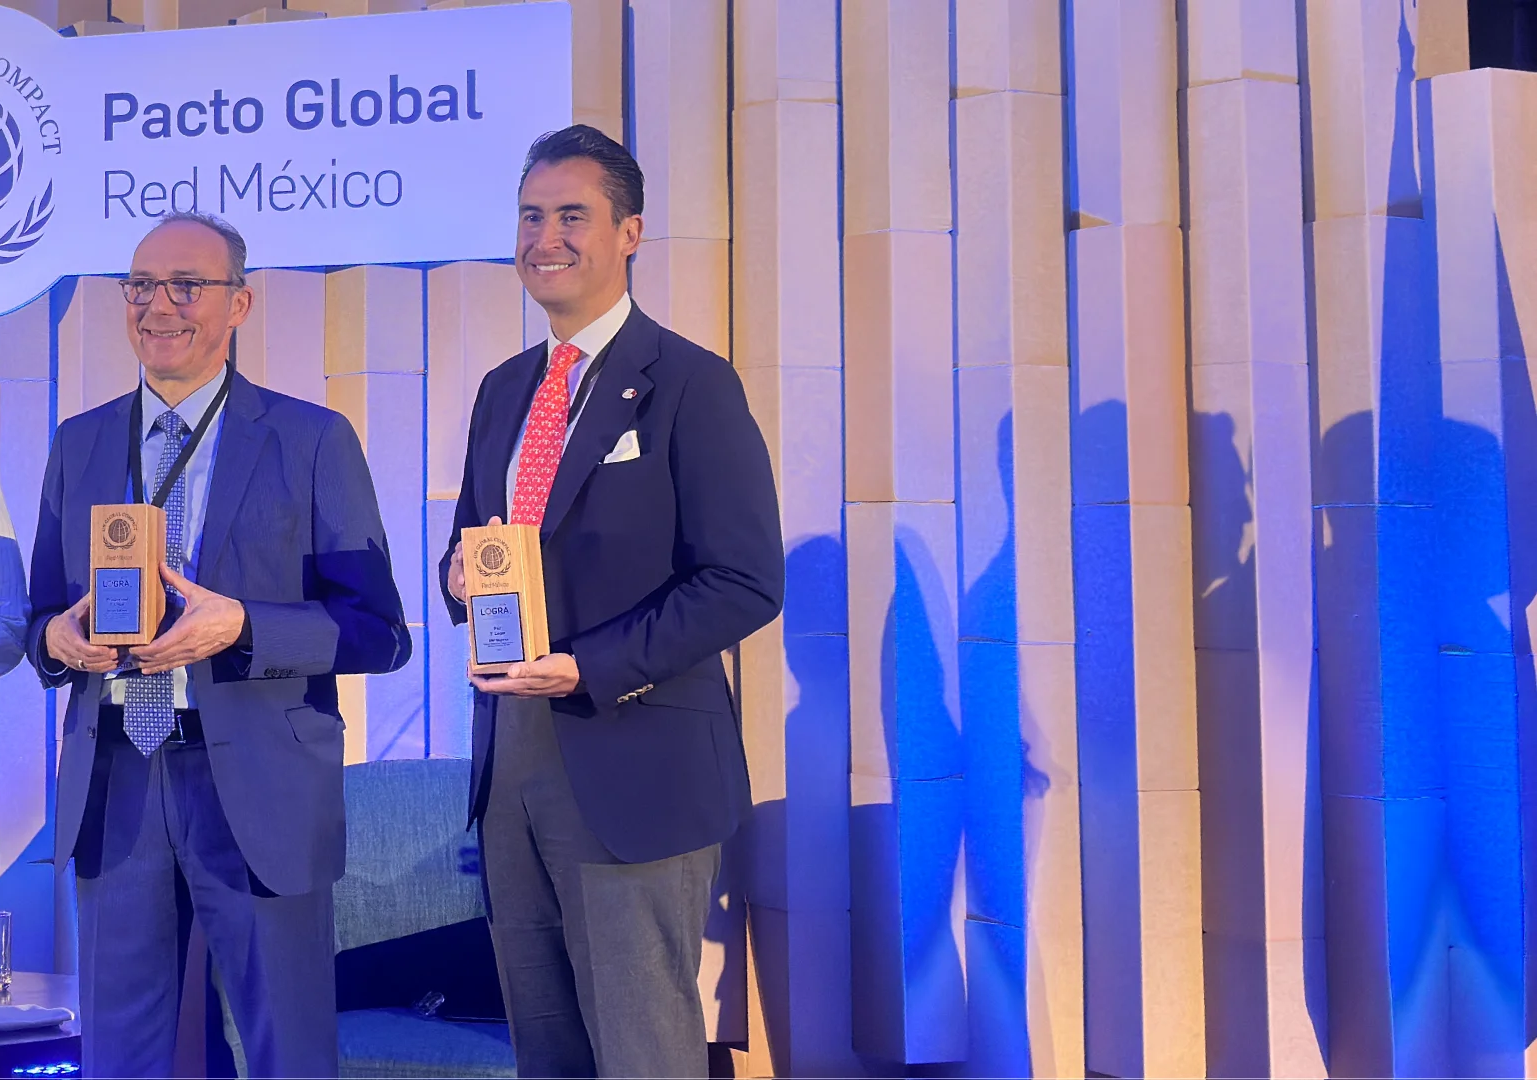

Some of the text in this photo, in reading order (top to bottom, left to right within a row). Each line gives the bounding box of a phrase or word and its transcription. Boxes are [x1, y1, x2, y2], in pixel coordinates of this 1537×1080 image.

[103, 69, 484, 141] Pacto Global
[103, 157, 404, 219] Red México
